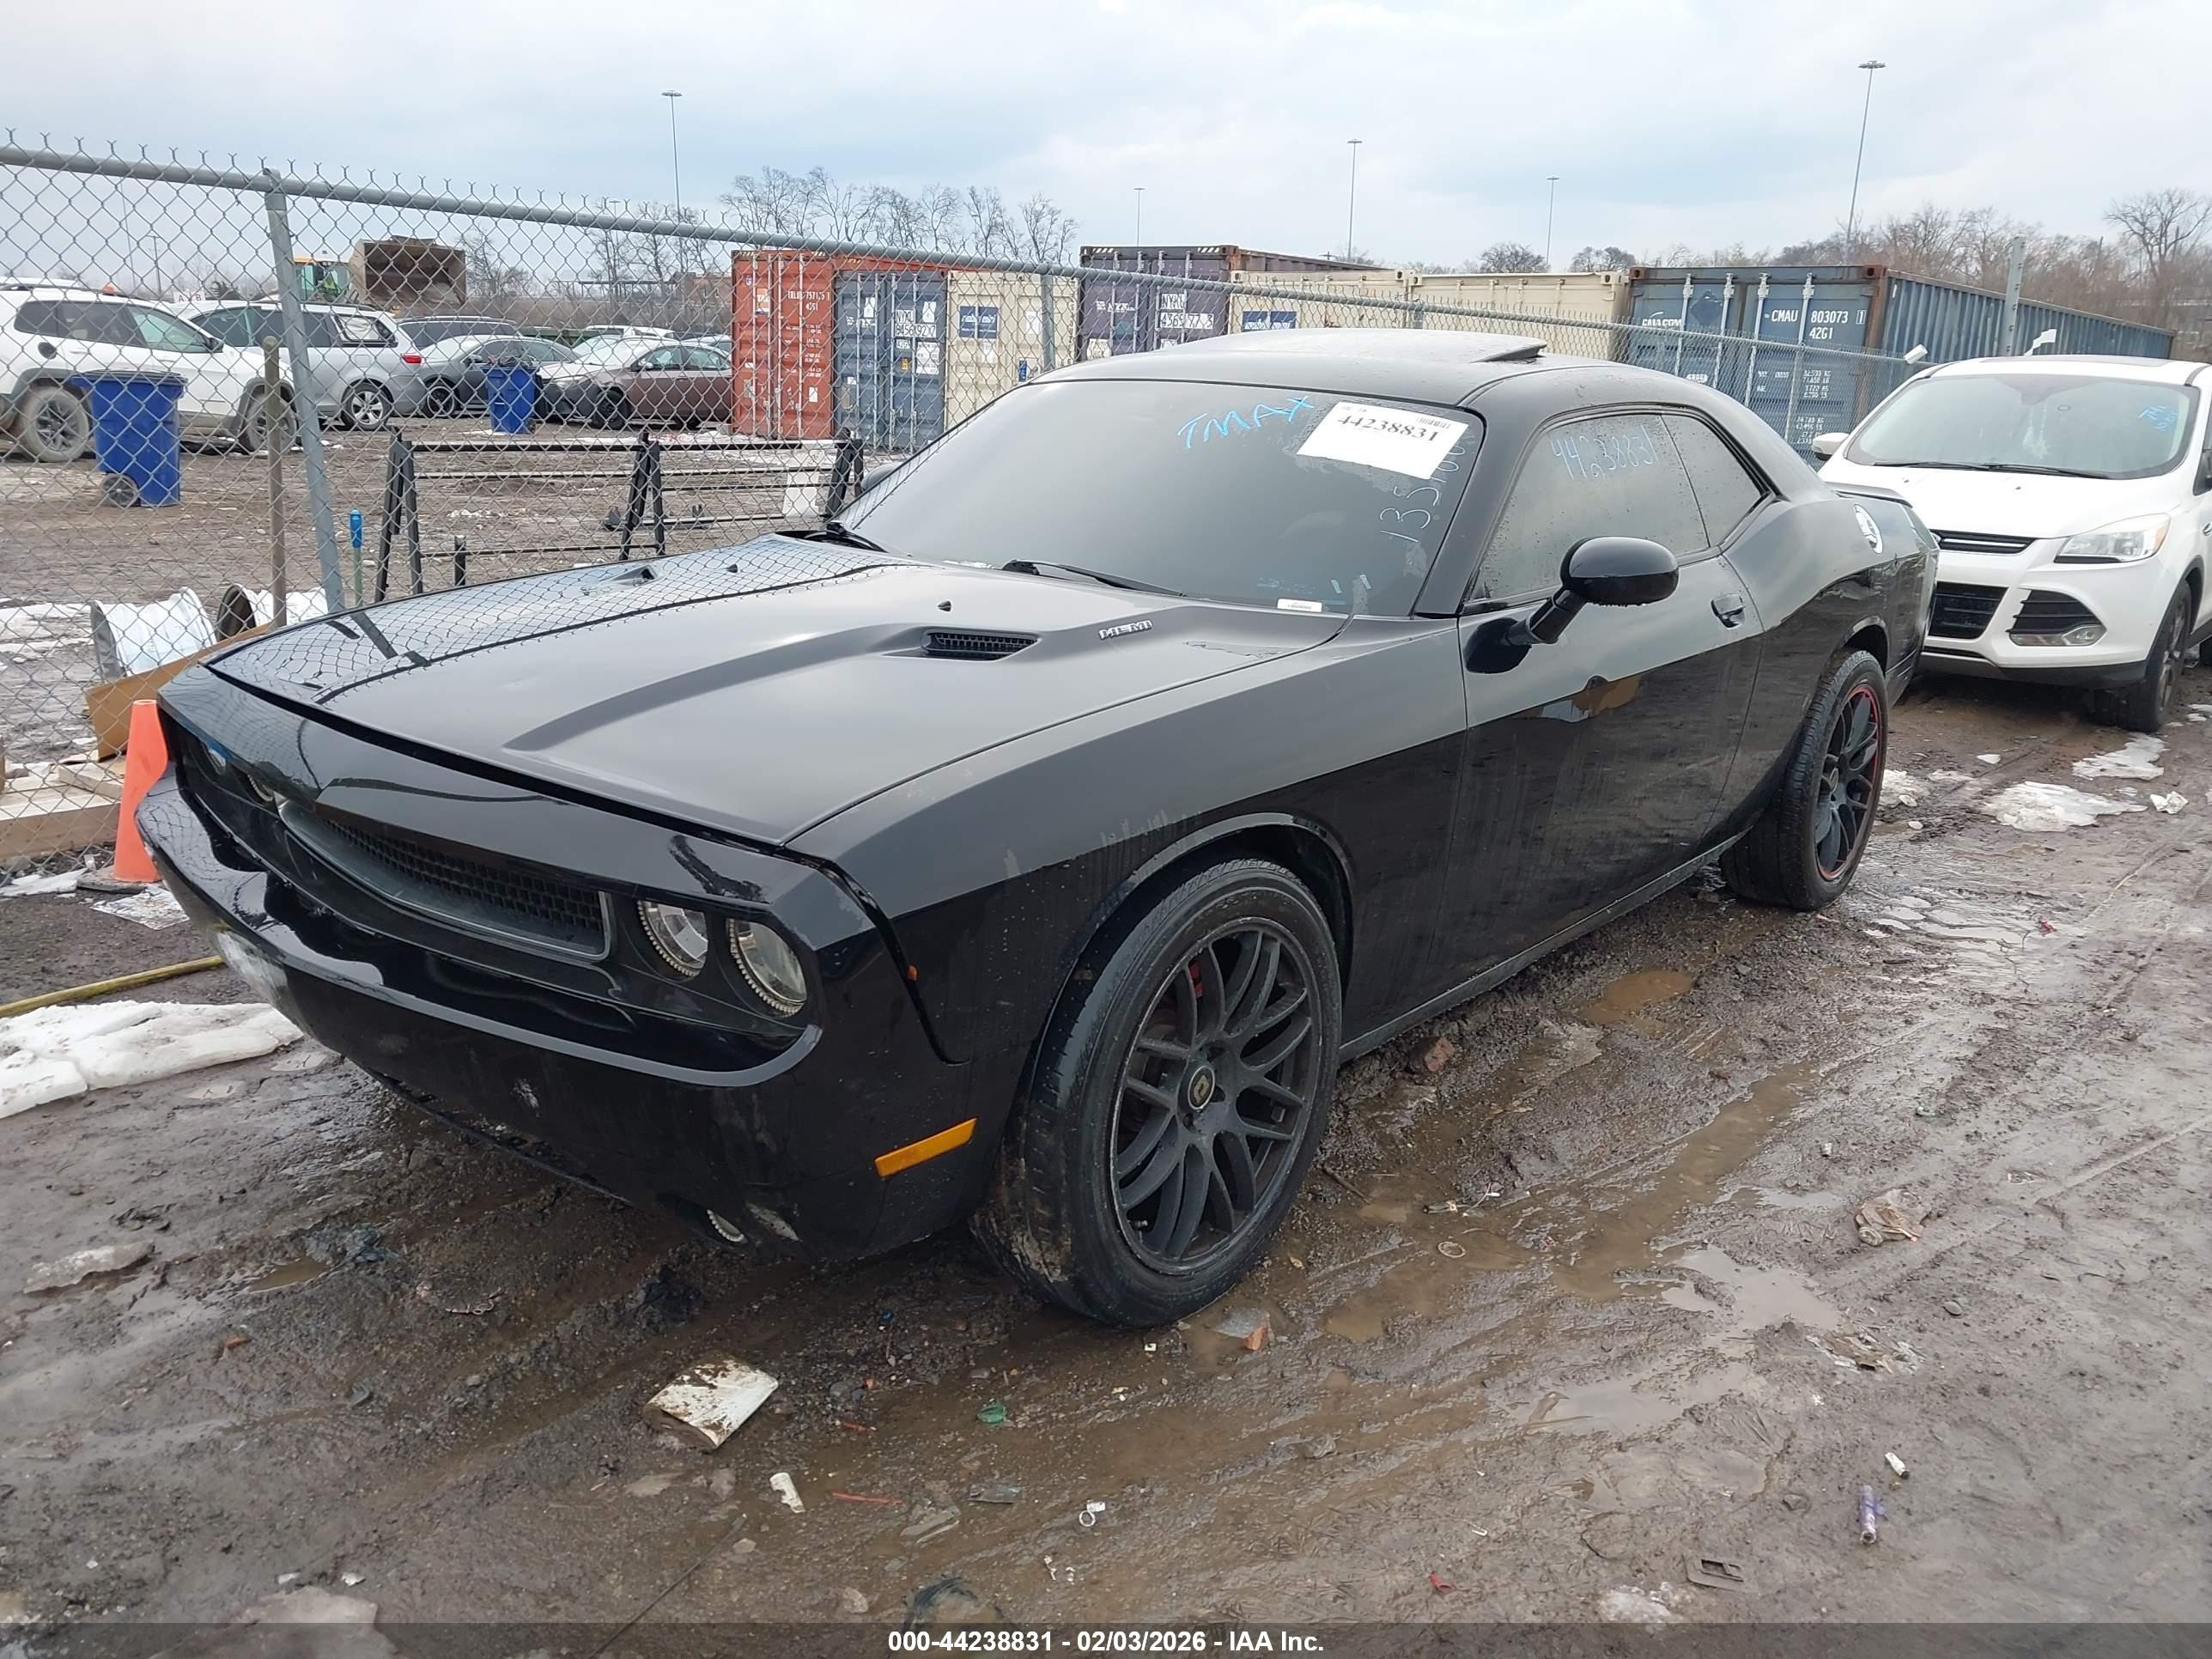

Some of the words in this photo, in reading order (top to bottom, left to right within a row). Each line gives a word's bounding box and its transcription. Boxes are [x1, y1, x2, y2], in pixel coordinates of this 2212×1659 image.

[1771, 310, 1799, 322] CMAU
[1811, 310, 1849, 324] 803073
[1856, 310, 1866, 324] 1
[1809, 327, 1833, 340] 42G1
[1177, 396, 1315, 448] TMAX
[1337, 415, 1439, 441] 44238831
[1551, 424, 1658, 481] 44238831
[1099, 620, 1153, 640] HEMI
